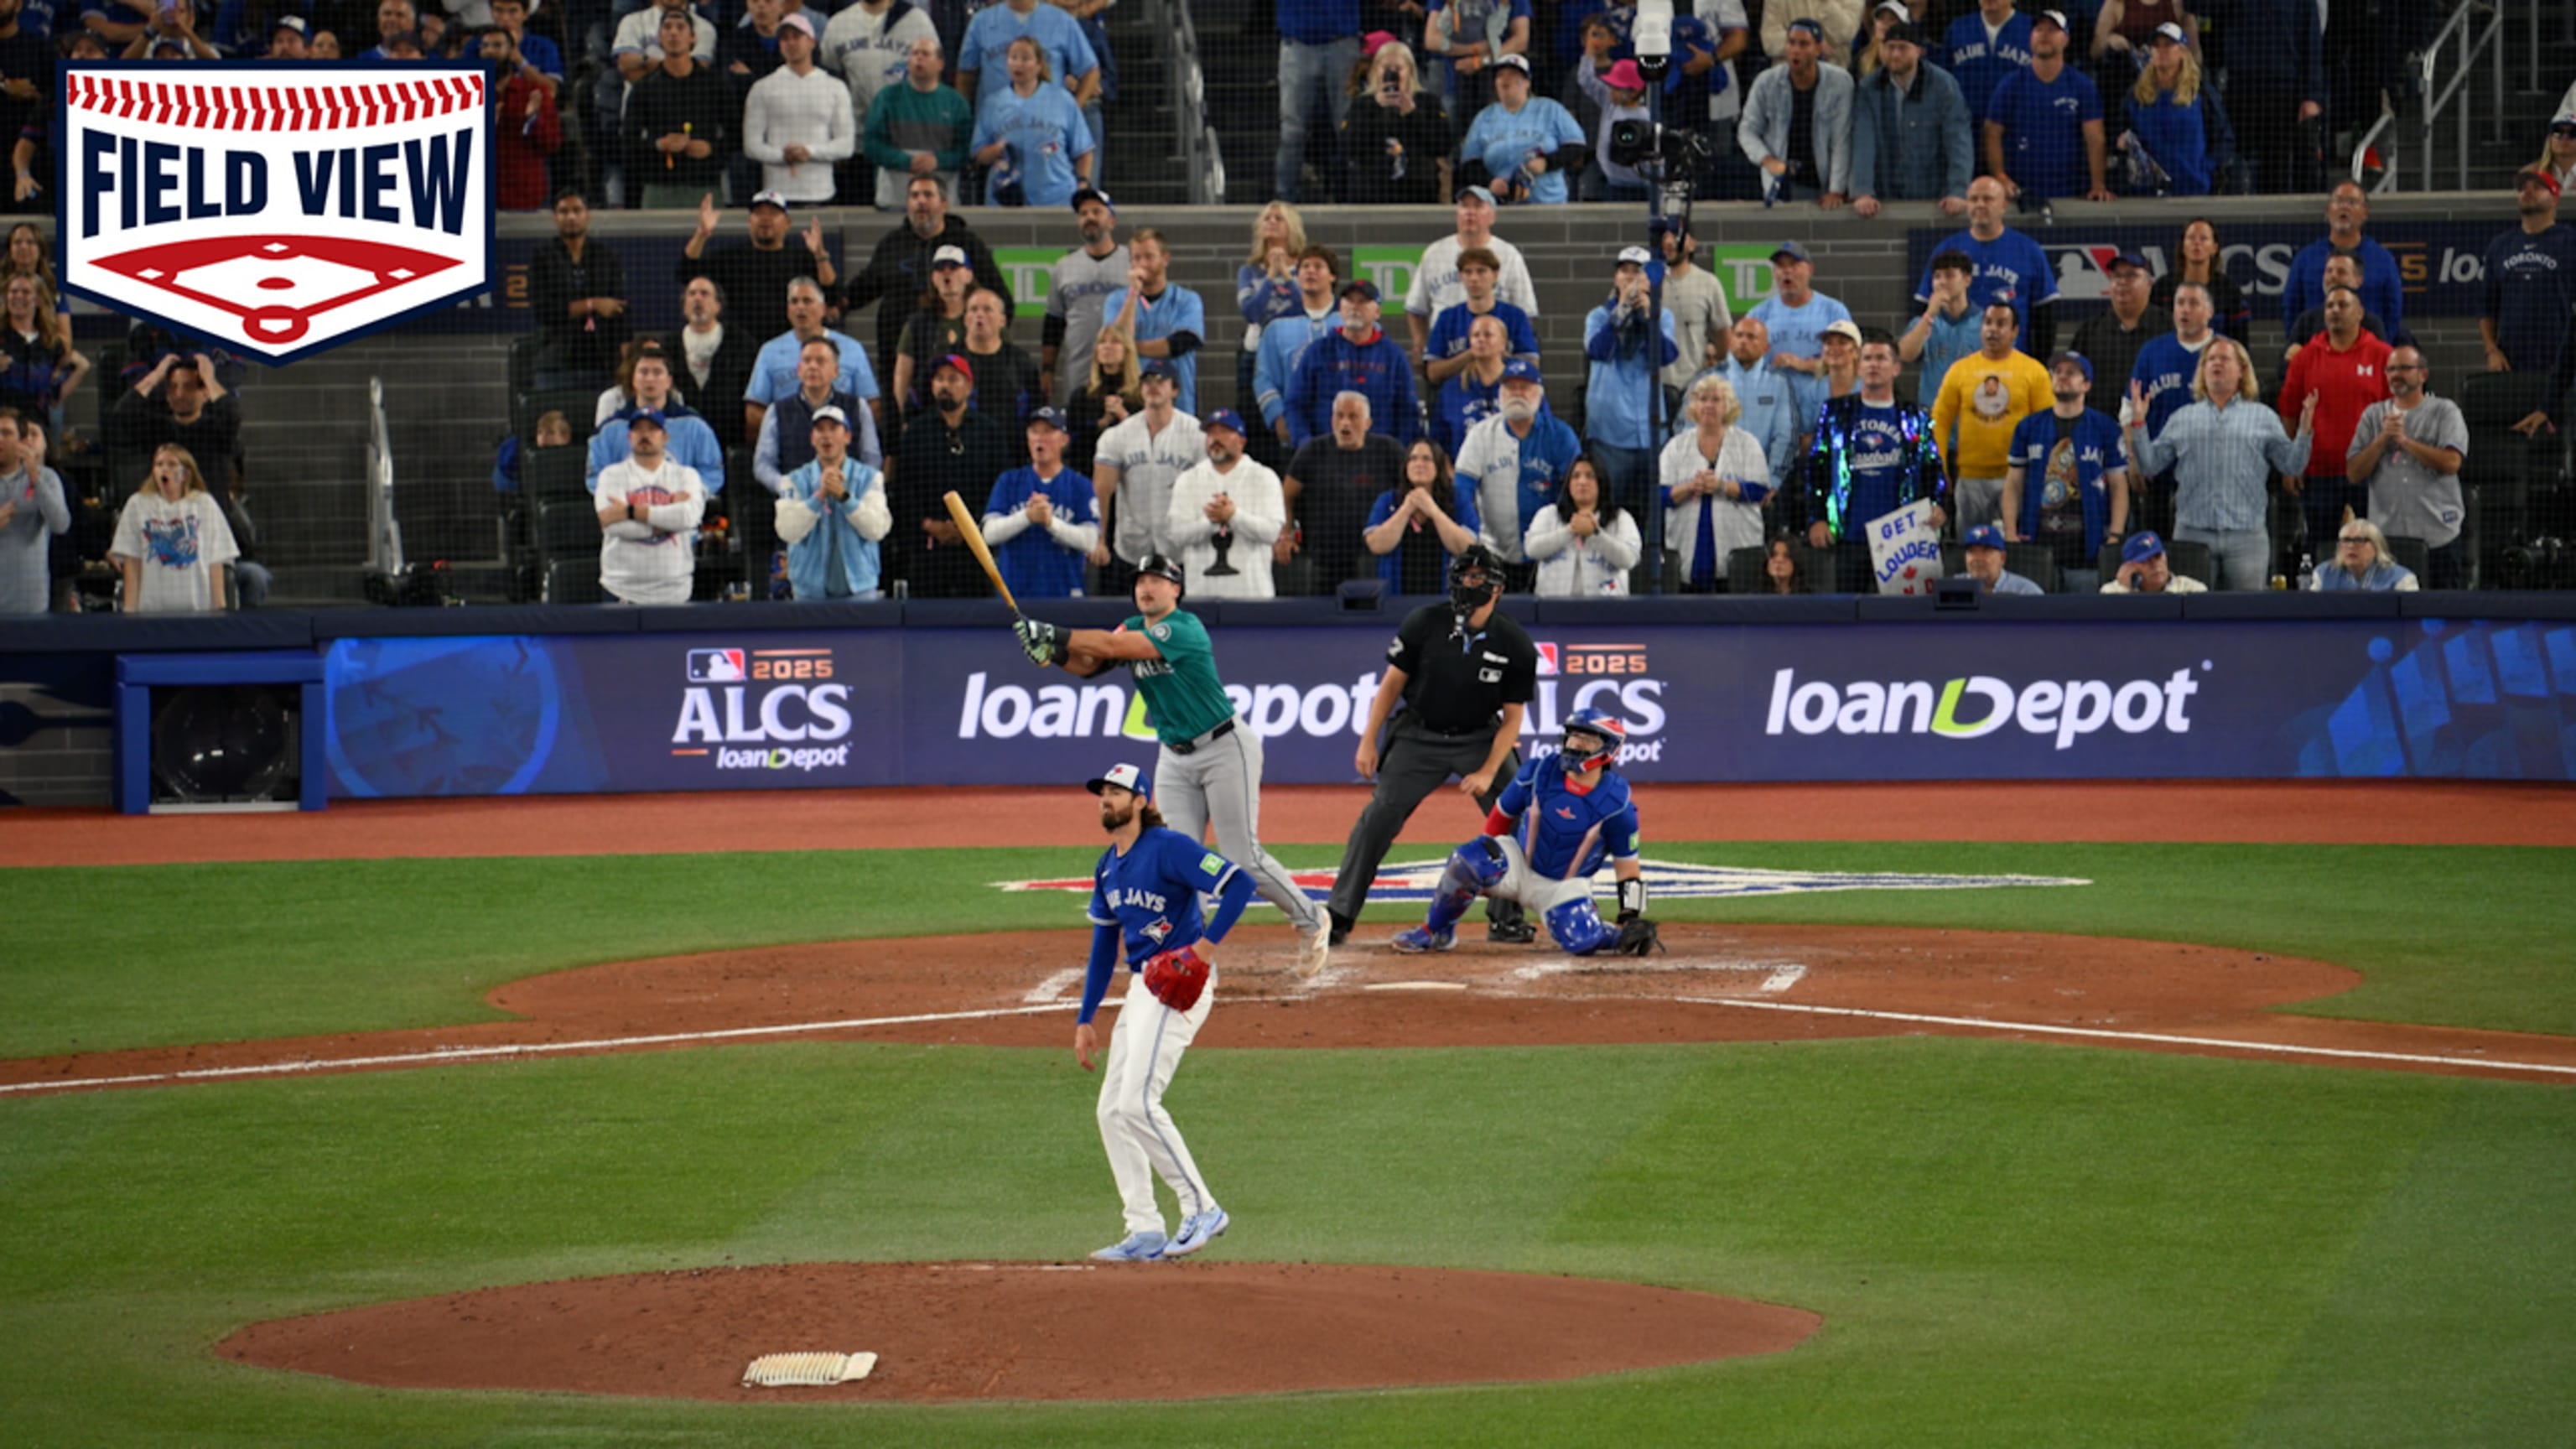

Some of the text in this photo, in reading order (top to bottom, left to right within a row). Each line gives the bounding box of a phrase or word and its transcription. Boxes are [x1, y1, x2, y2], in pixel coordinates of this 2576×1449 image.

[1952, 44, 1983, 65] BLUE
[2503, 252, 2558, 270] TORONTO
[1358, 260, 1419, 302] TD
[1881, 511, 1917, 540] GET
[1876, 540, 1940, 583] LOUDER
[753, 659, 834, 680] 2025
[1566, 655, 1647, 673] 2025
[672, 683, 852, 743] ALCS
[1765, 667, 2199, 750] loanDepot
[716, 745, 849, 771] loanDepot
[1124, 887, 1166, 912] JAYS
